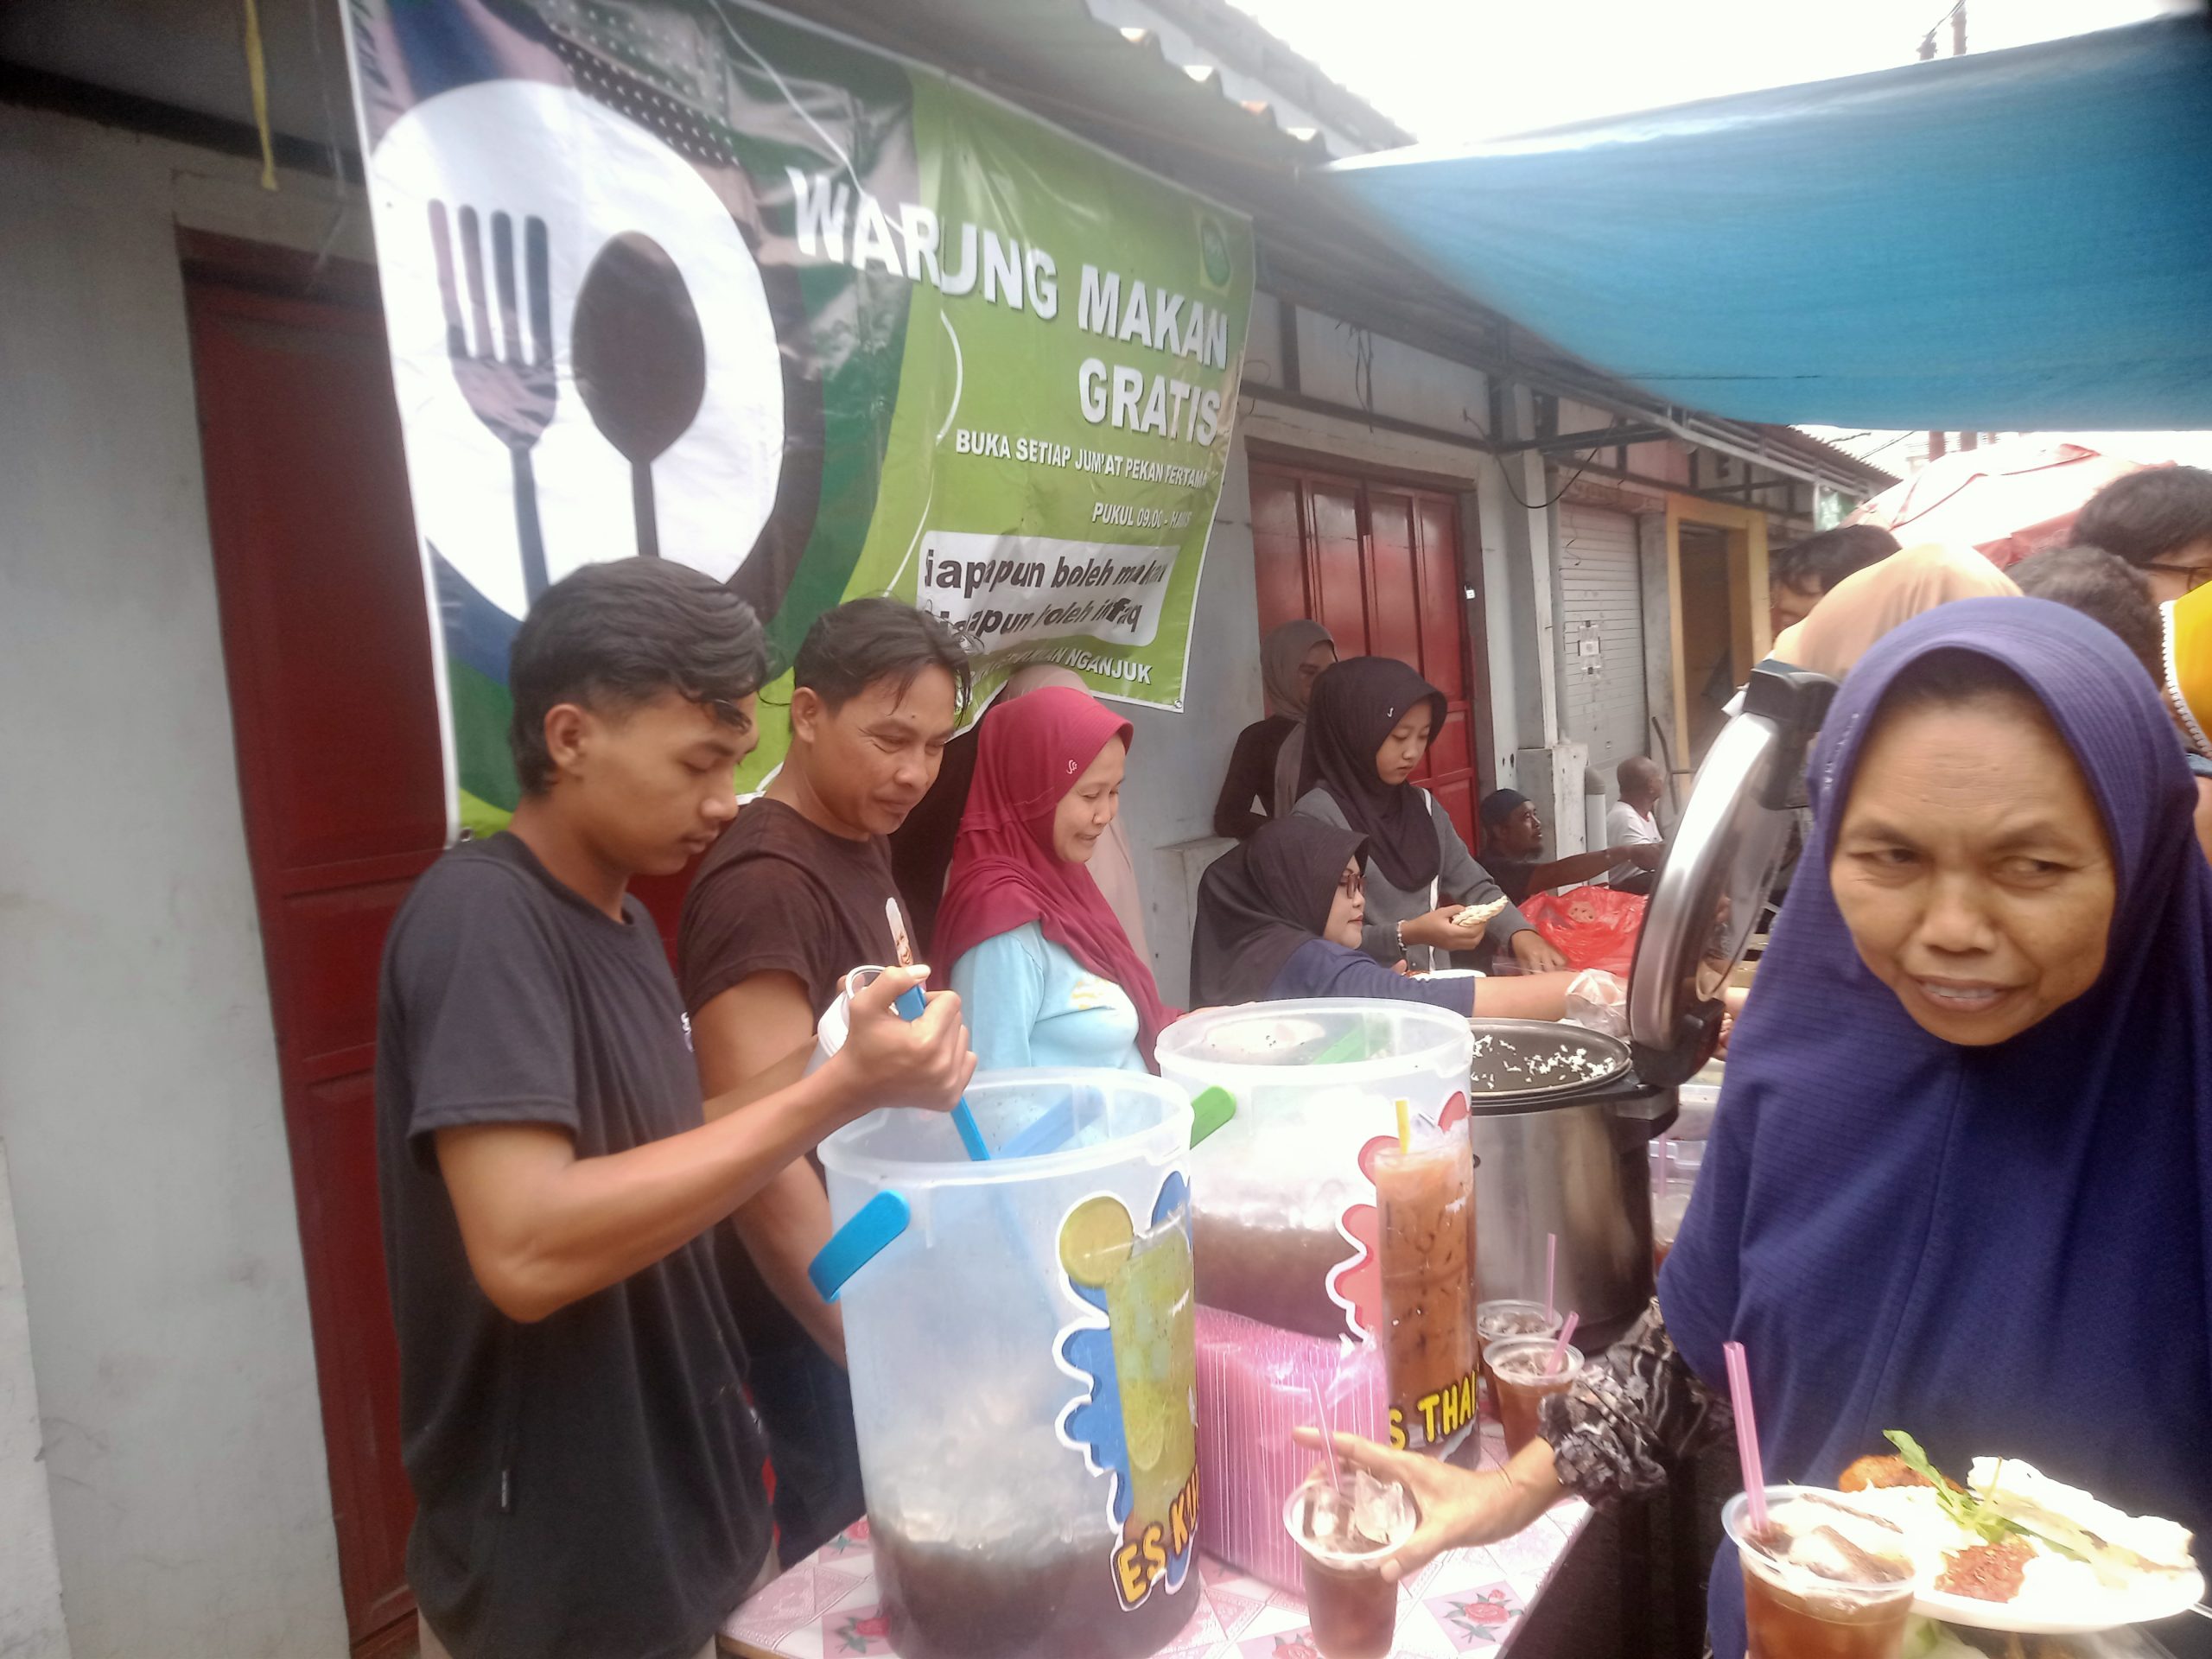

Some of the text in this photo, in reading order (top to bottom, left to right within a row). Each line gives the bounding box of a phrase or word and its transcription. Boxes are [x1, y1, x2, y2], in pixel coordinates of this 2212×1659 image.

[785, 166, 1228, 370] WARUNG MAKAN
[1077, 357, 1221, 447] GRATIS
[956, 429, 1011, 460] BUKA
[1015, 437, 1071, 467] SETIAP
[1125, 457, 1164, 483] PEKAN
[1092, 501, 1134, 527] PUKUL
[1136, 507, 1163, 528] 09.00
[1051, 556, 1114, 588] boleh
[1065, 649, 1153, 684] NGANJUK
[1389, 1407, 1406, 1450] S
[1117, 1525, 1166, 1603] ES
